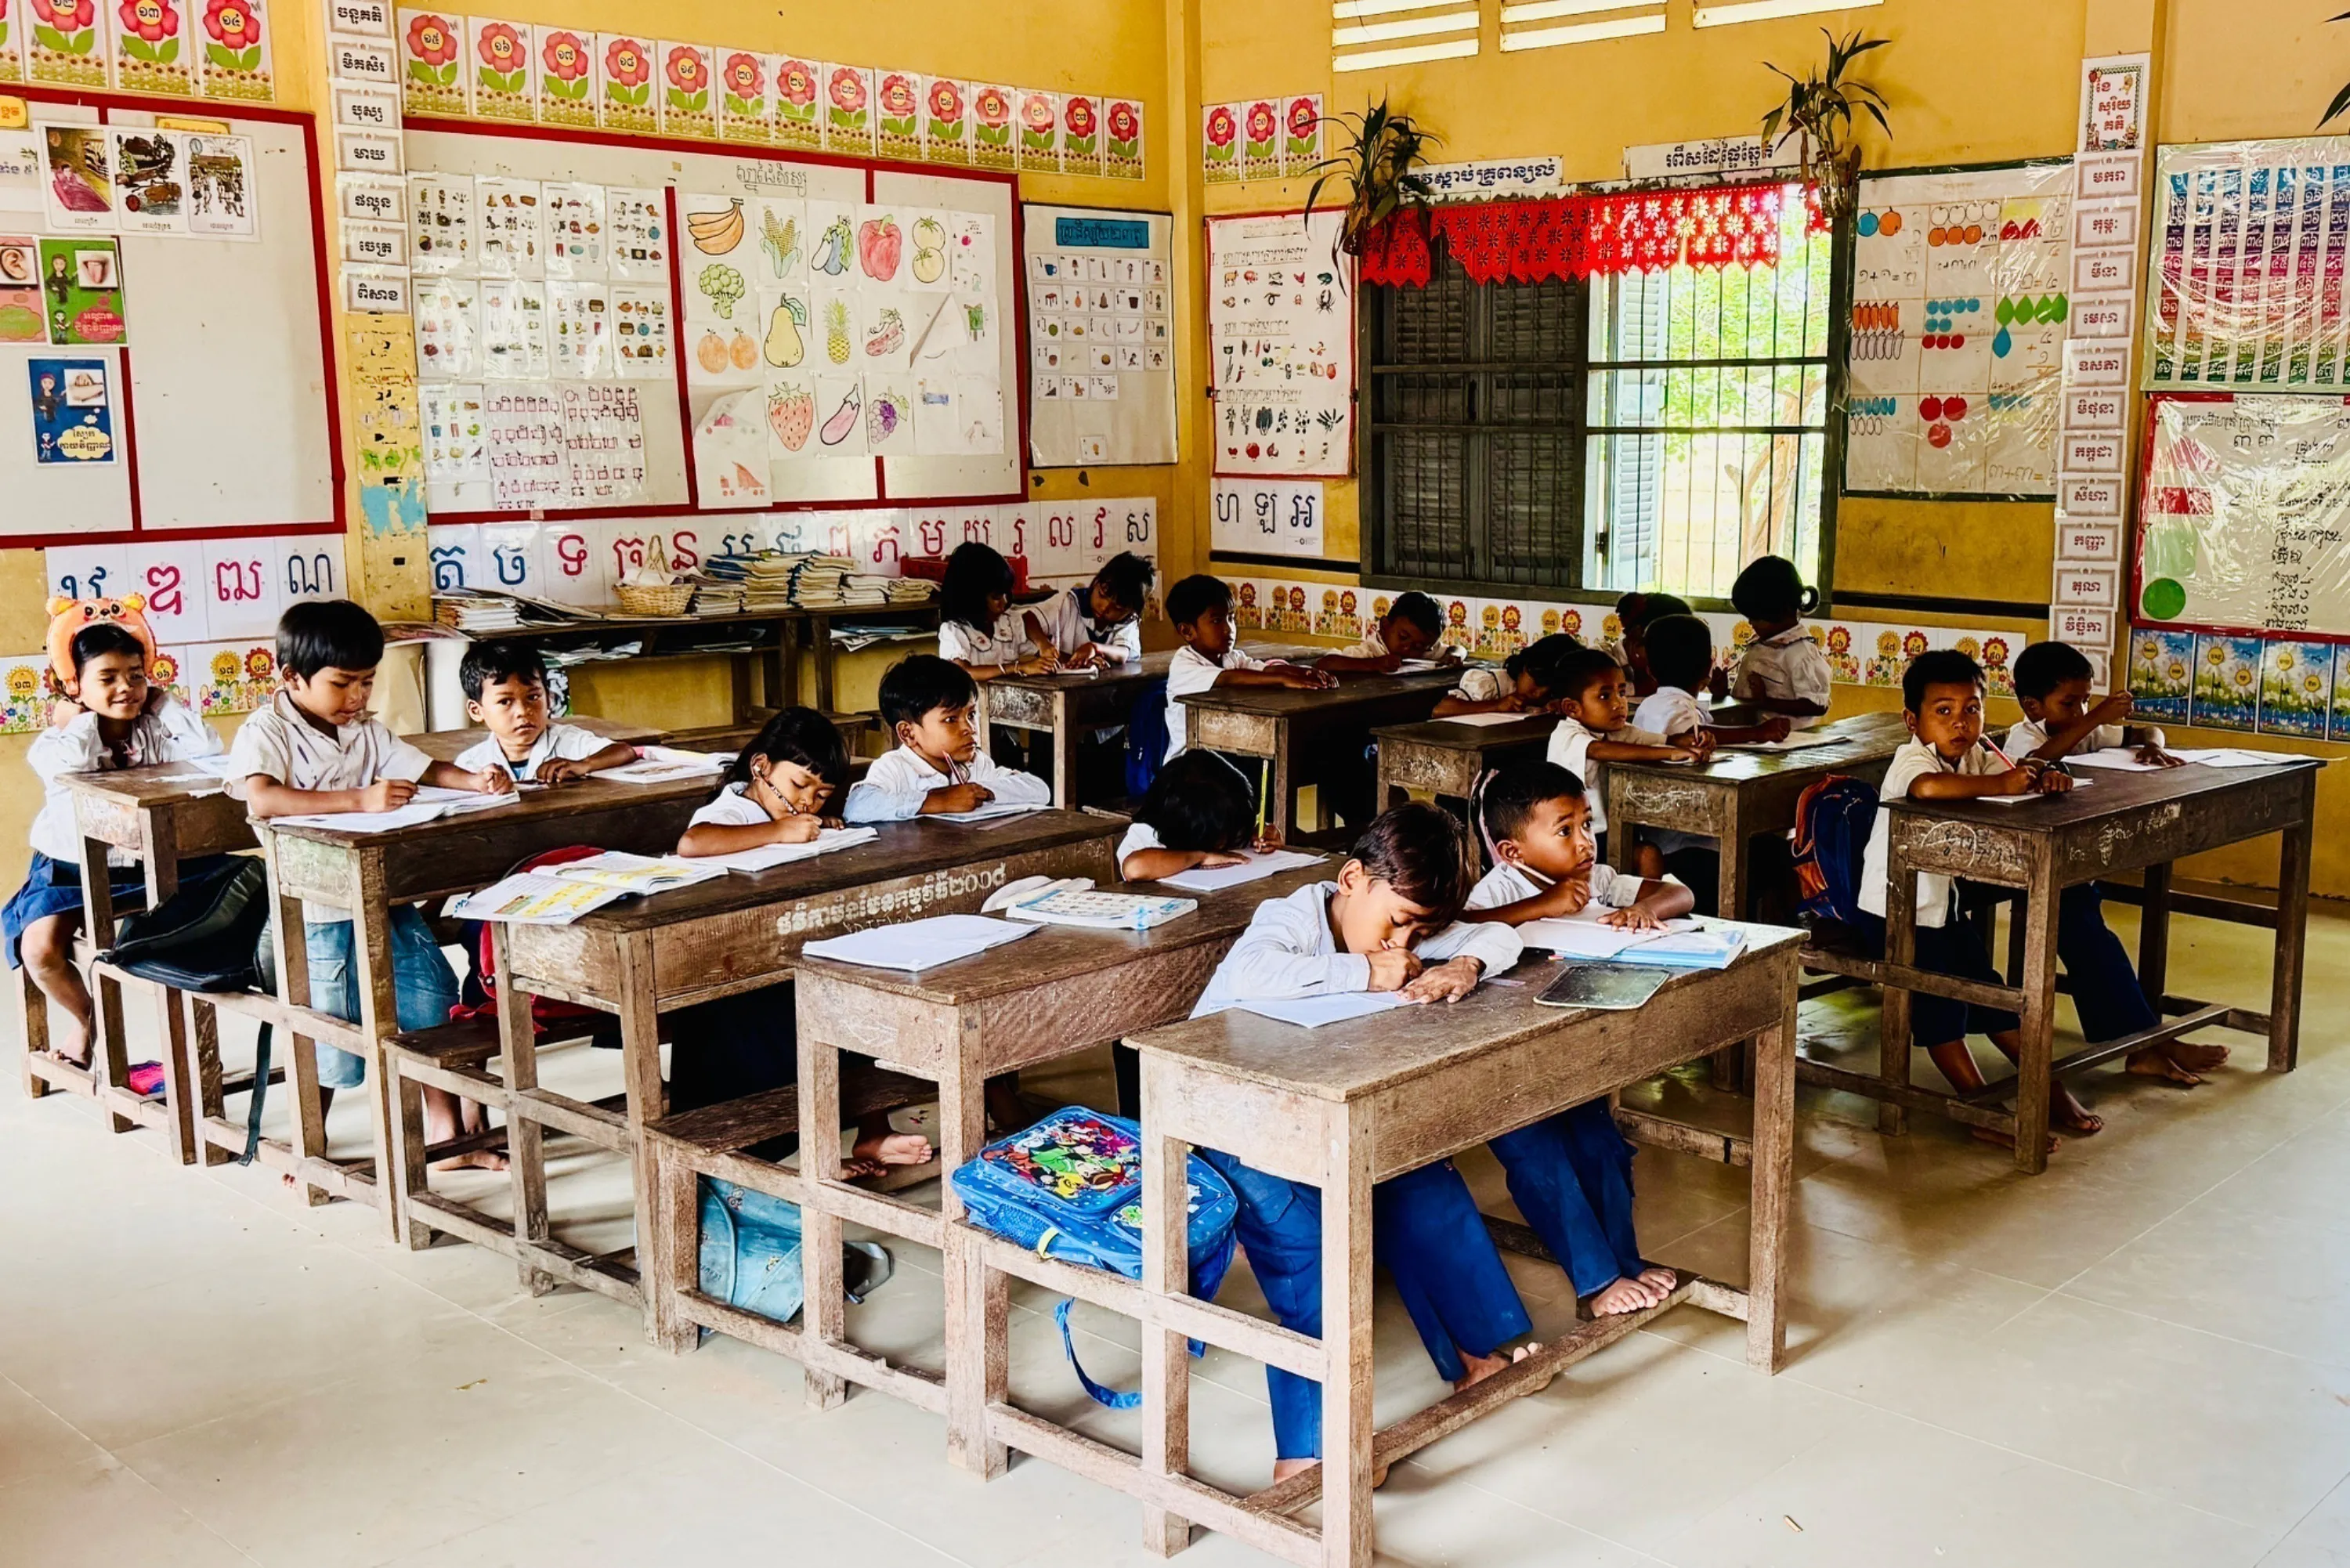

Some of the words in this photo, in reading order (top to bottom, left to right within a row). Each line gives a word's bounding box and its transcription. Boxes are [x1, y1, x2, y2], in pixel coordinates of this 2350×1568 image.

[139, 7, 159, 18] ១៣
[223, 13, 241, 26] ១៤
[495, 42, 510, 52] ១៦
[2093, 170, 2125, 183] មករា
[2083, 313, 2117, 325] មេសា
[1216, 492, 1239, 524] ហ
[1255, 492, 1278, 534] ឡ
[1290, 493, 1316, 529] អ
[429, 545, 465, 591] ត
[558, 533, 588, 576] ទ
[919, 518, 945, 555] ម
[1012, 516, 1026, 555] រ
[1049, 515, 1075, 548] ល
[1094, 506, 1107, 549] វ
[1126, 511, 1150, 543] ស
[146, 565, 181, 616] ឌ
[216, 561, 262, 602] ឍ
[288, 554, 332, 594] ណ
